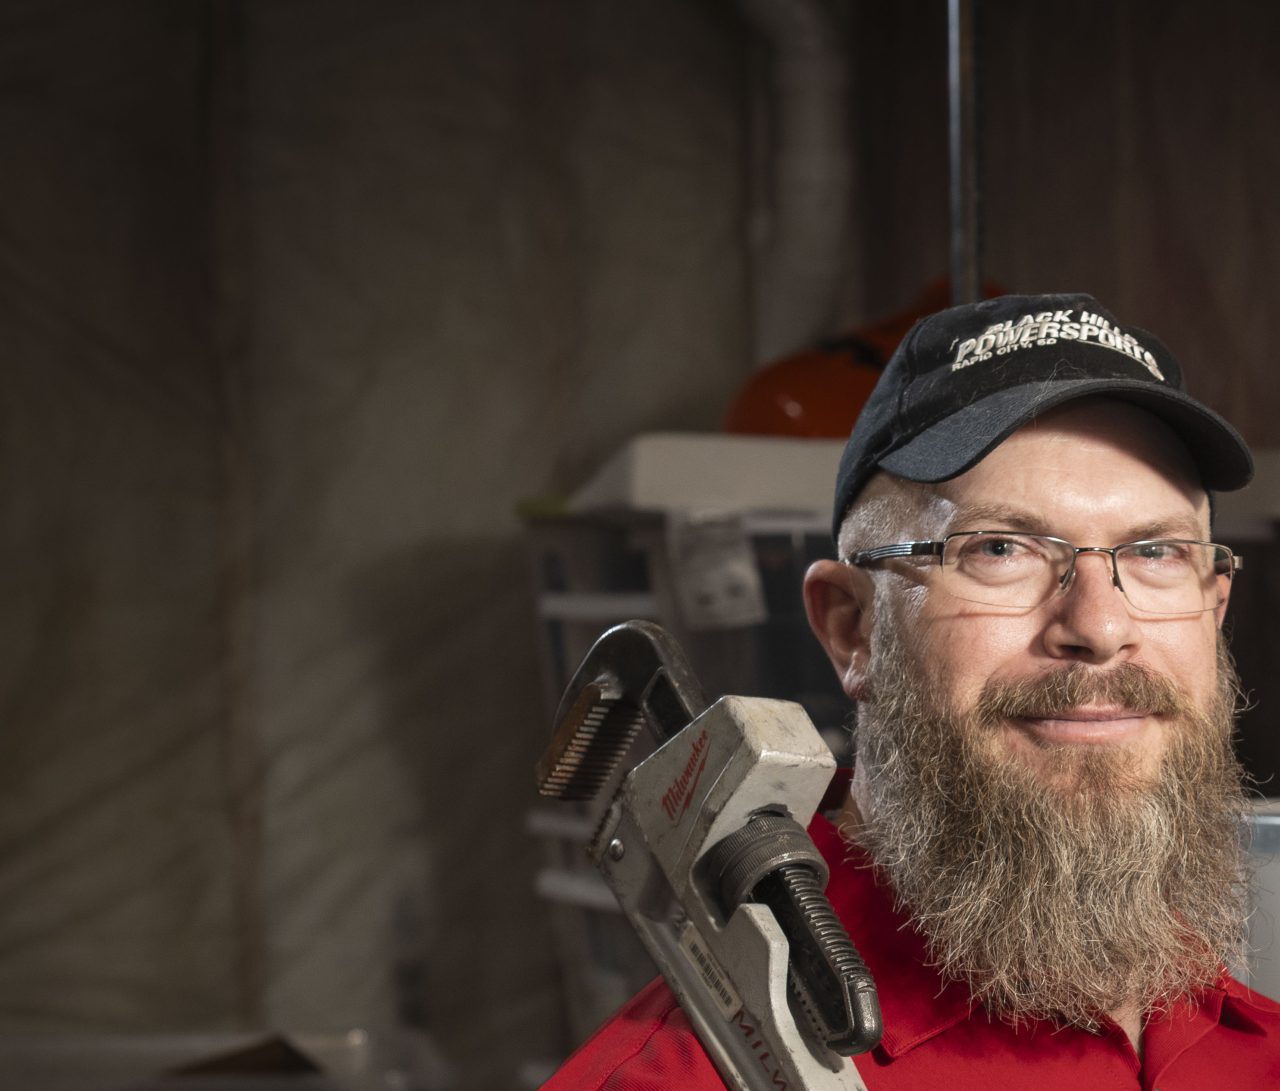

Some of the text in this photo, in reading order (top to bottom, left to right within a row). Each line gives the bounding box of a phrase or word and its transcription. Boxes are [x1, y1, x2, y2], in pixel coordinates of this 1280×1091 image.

[985, 309, 1074, 335] BLACK
[952, 352, 993, 372] RAPID
[954, 321, 1159, 370] POWERSPORTS
[661, 729, 708, 822] Milwaukee
